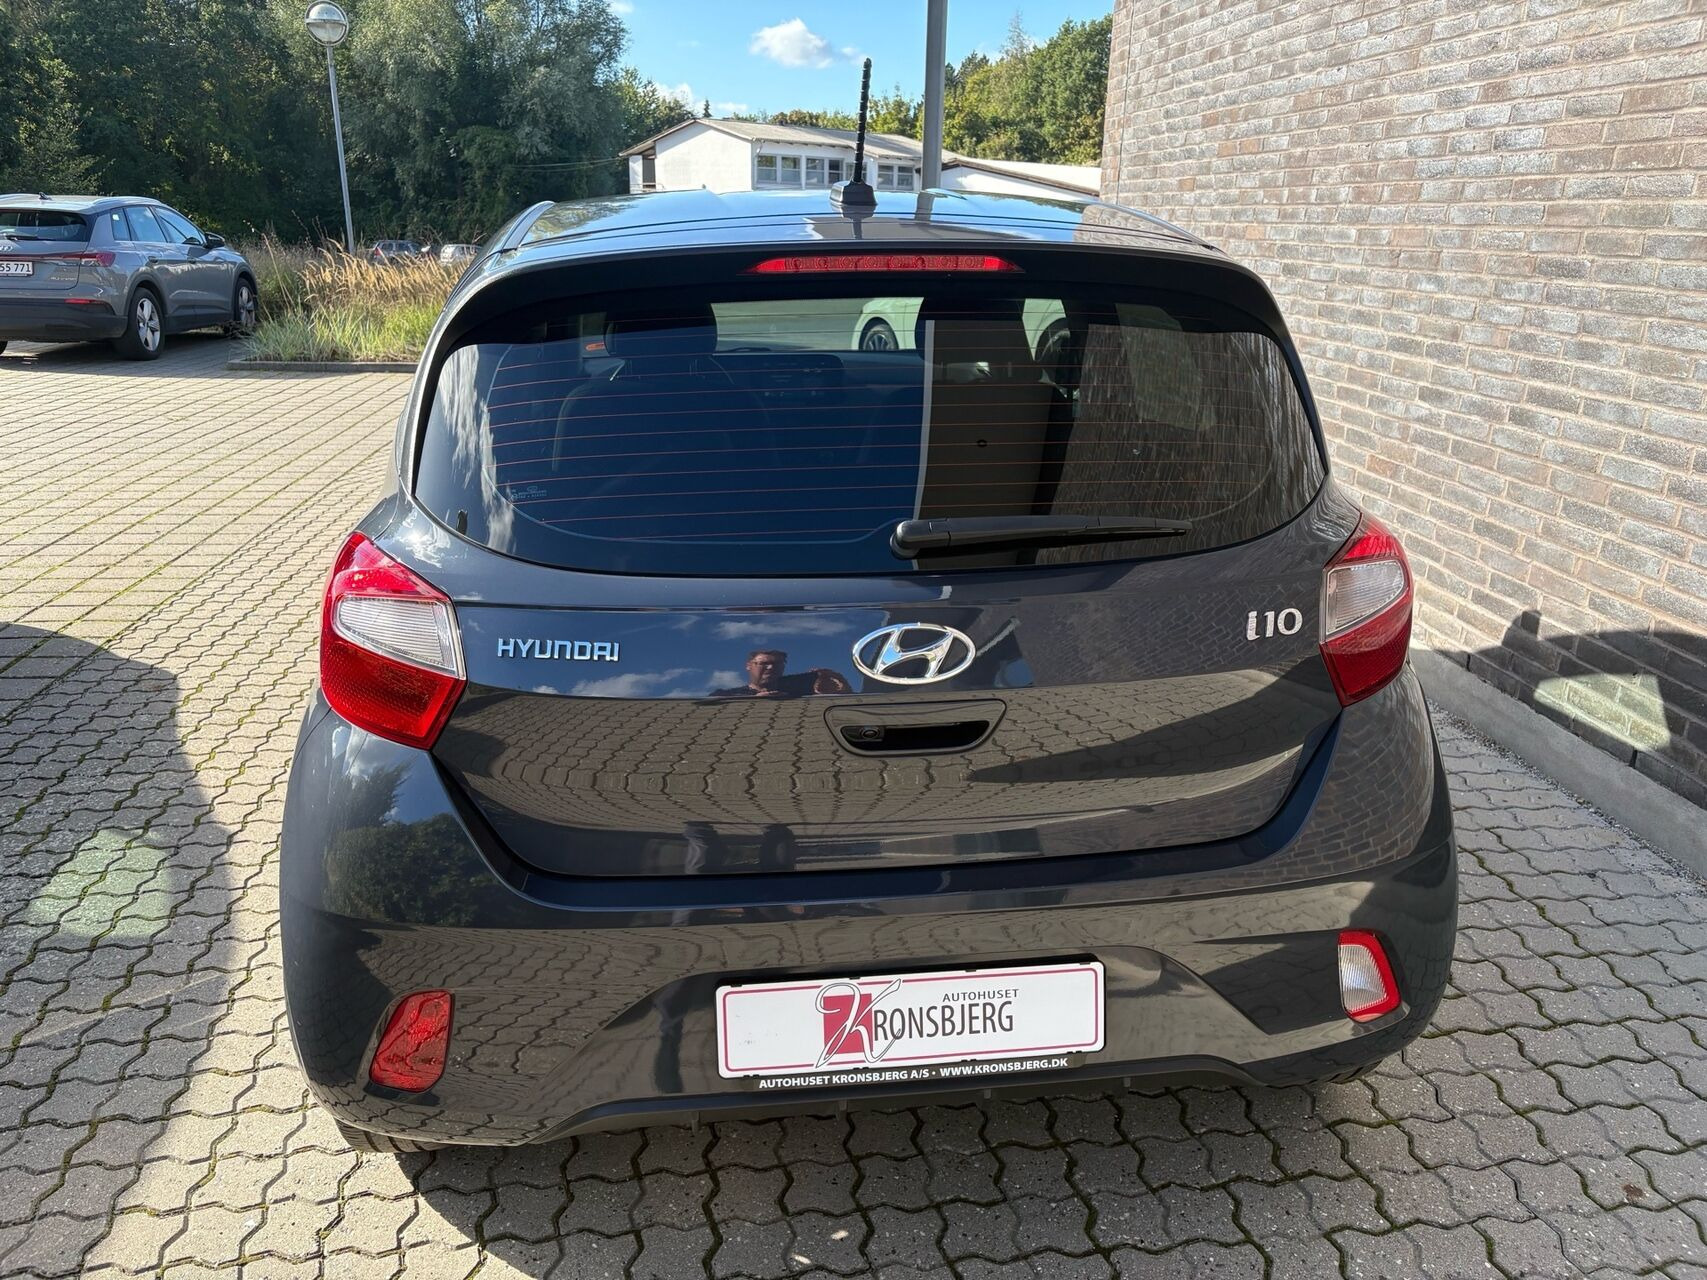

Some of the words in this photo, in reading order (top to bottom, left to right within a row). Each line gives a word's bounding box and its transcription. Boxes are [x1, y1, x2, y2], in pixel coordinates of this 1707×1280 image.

[14, 263, 31, 273] 771
[497, 638, 620, 662] HYUNDAI
[942, 988, 1020, 1003] AUTOHUSET
[815, 978, 1014, 1069] KRONSBJERG
[759, 1075, 831, 1089] AUTOHUSET
[832, 1070, 909, 1084] KRONSBJERG
[910, 1068, 930, 1080] A/S
[939, 1057, 1068, 1077] WWW.KRONSBJERG.DK
